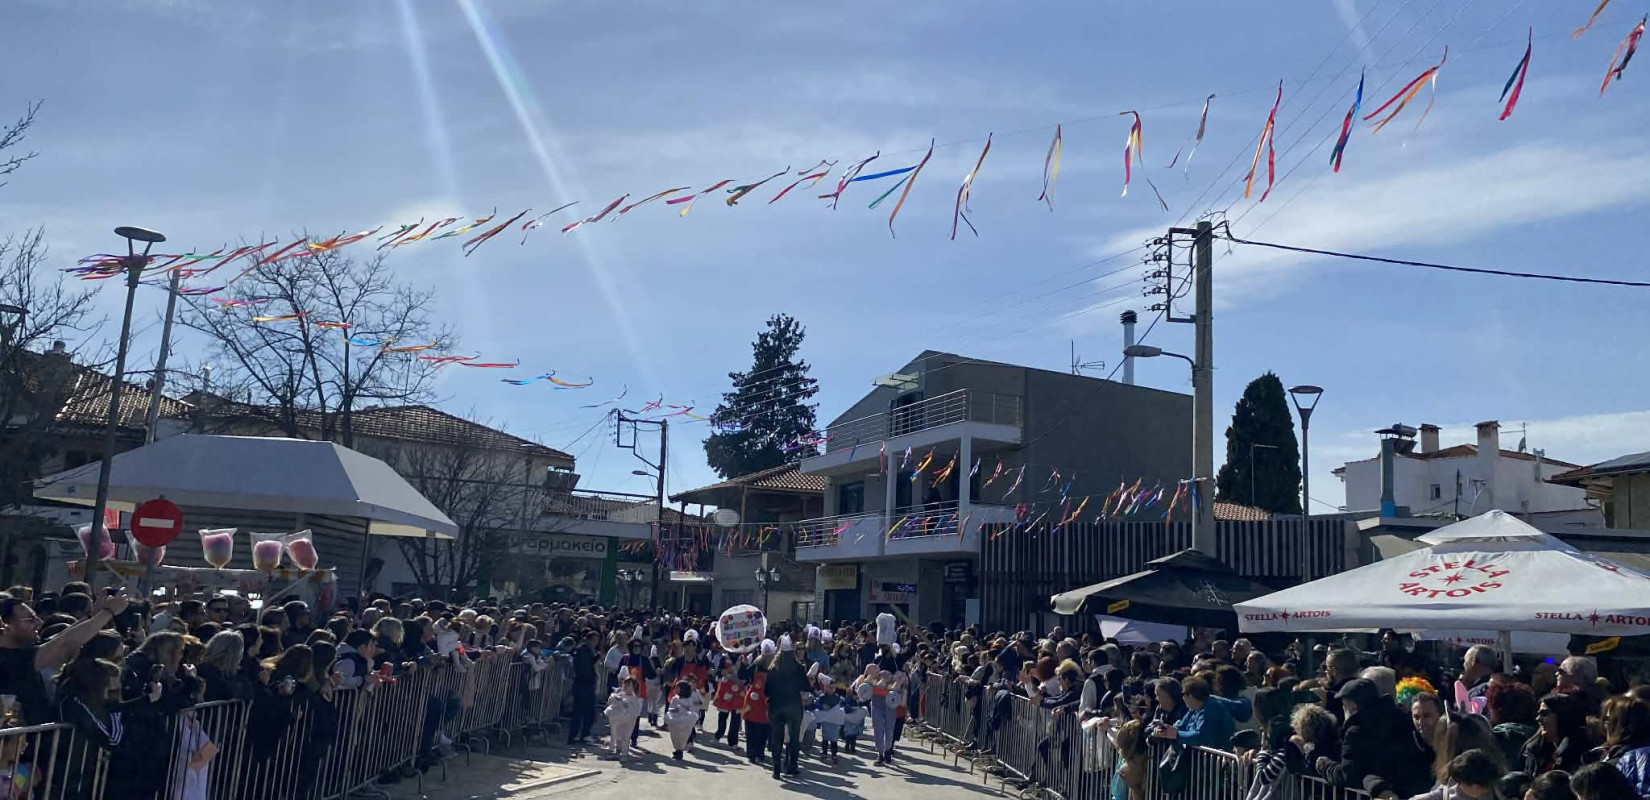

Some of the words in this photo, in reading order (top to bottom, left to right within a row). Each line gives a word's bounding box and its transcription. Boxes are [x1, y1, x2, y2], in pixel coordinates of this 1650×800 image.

[512, 537, 605, 554] αρμακείο
[1409, 559, 1510, 579] STELLA
[1399, 581, 1502, 599] ARTOIS
[1244, 612, 1278, 621] STELLA
[1291, 610, 1331, 619] ARTOIS
[1534, 612, 1584, 621] STELLA
